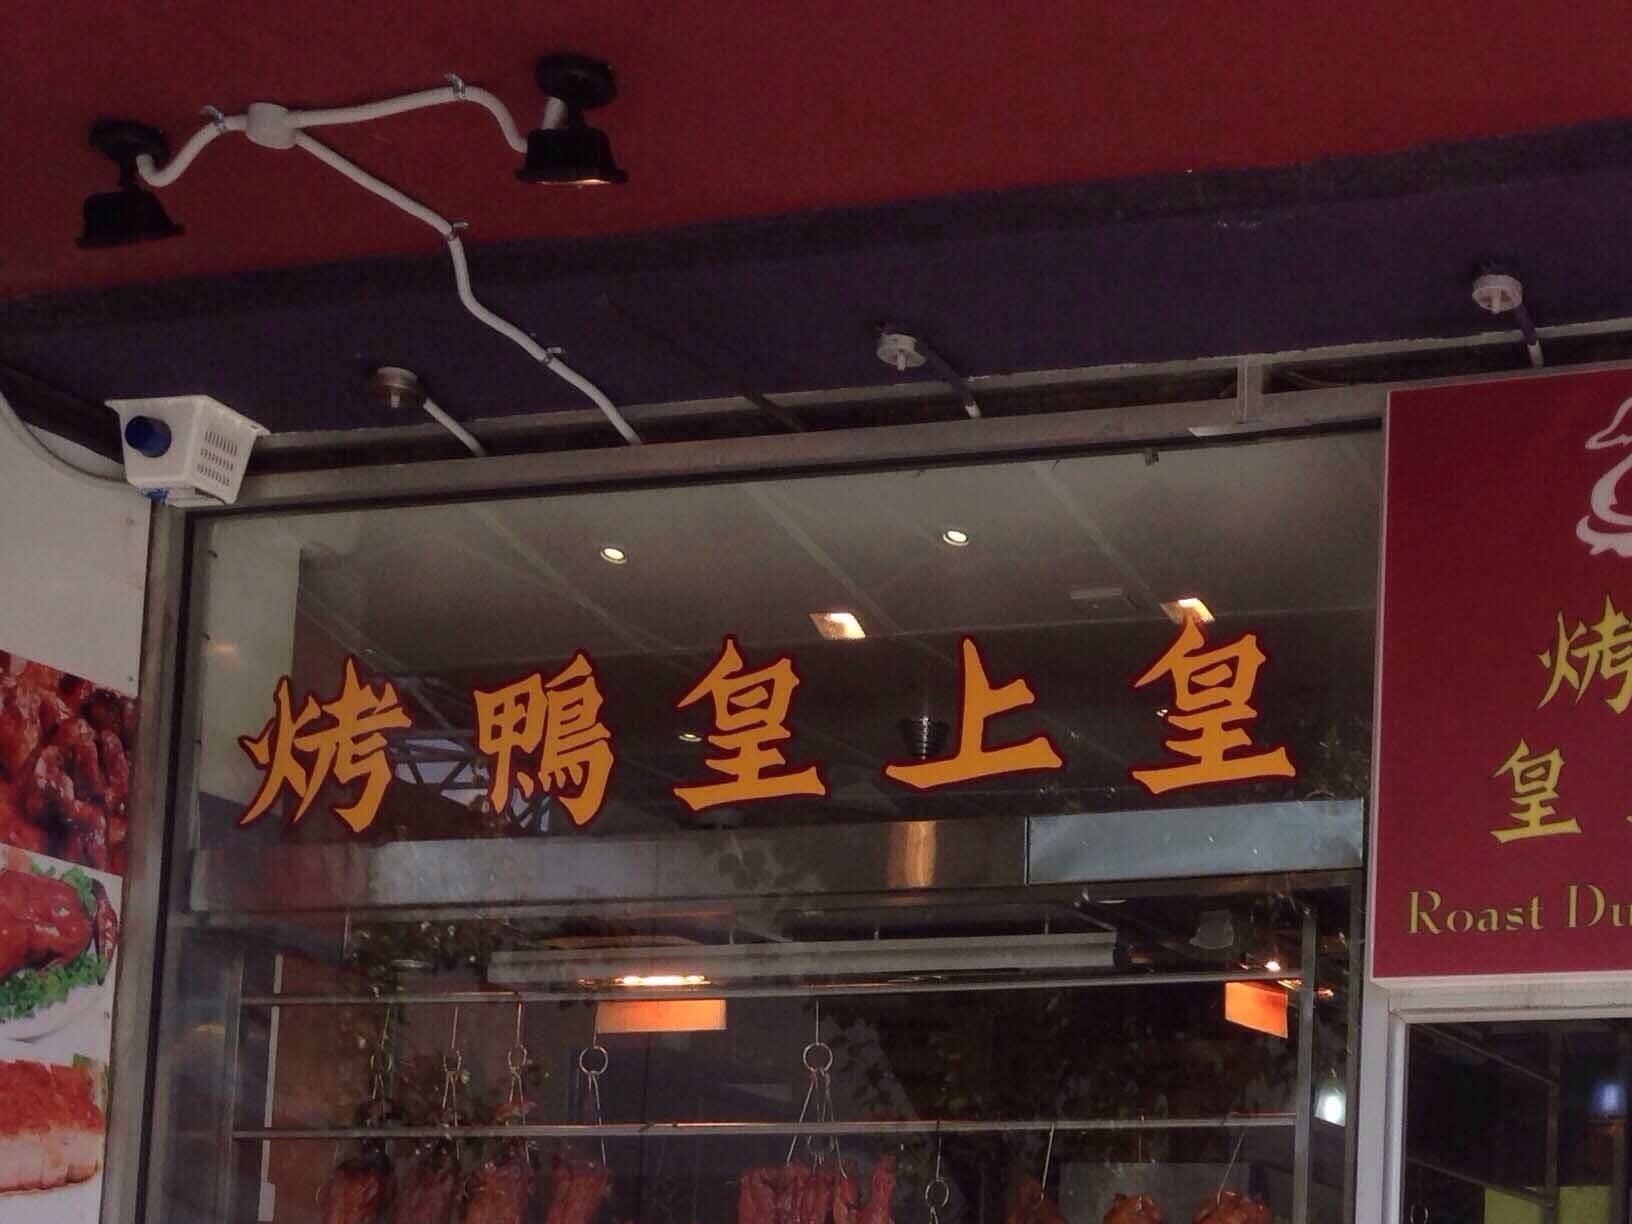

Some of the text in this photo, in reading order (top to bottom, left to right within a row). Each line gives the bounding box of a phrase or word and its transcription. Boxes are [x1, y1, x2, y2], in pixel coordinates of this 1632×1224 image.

[238, 614, 1297, 834] 烤鴨皇上皇
[1407, 888, 1544, 936] Roast
